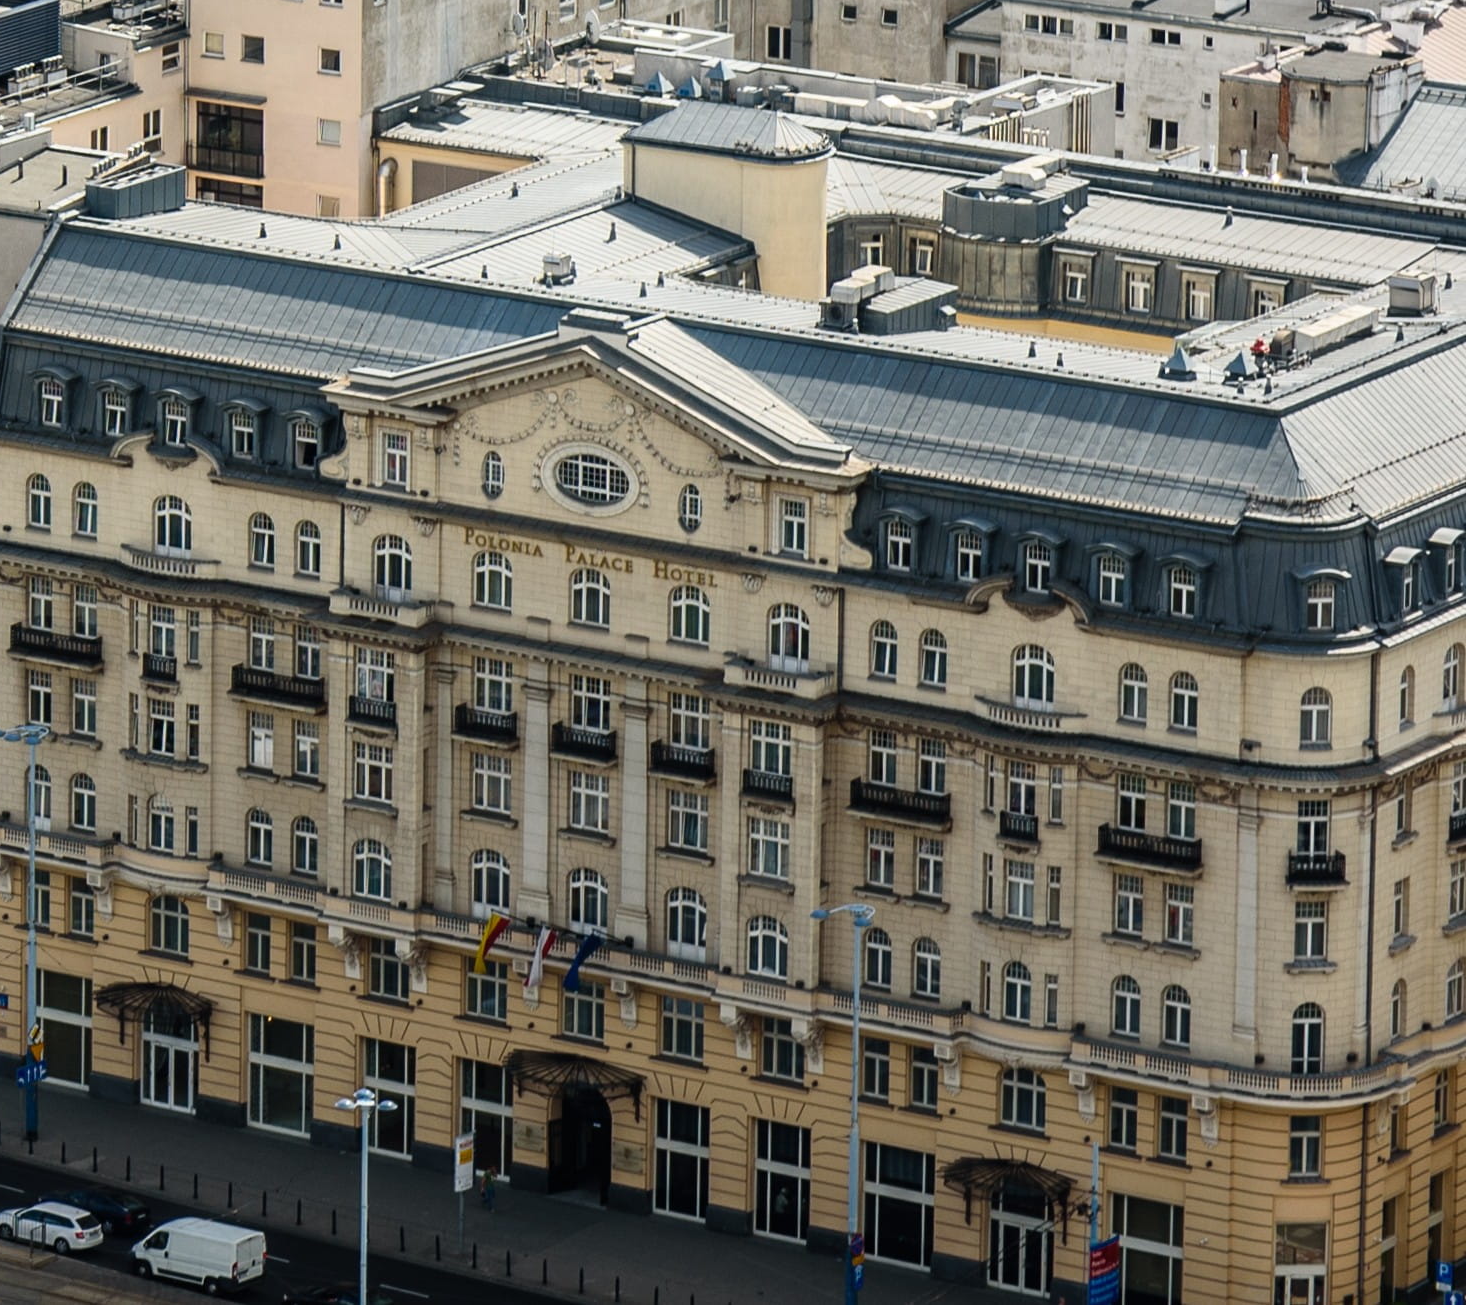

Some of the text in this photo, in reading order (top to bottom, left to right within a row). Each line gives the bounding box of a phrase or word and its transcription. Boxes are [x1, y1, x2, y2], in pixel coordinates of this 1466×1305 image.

[463, 526, 718, 590] POLONIA PALACE HOTEL
